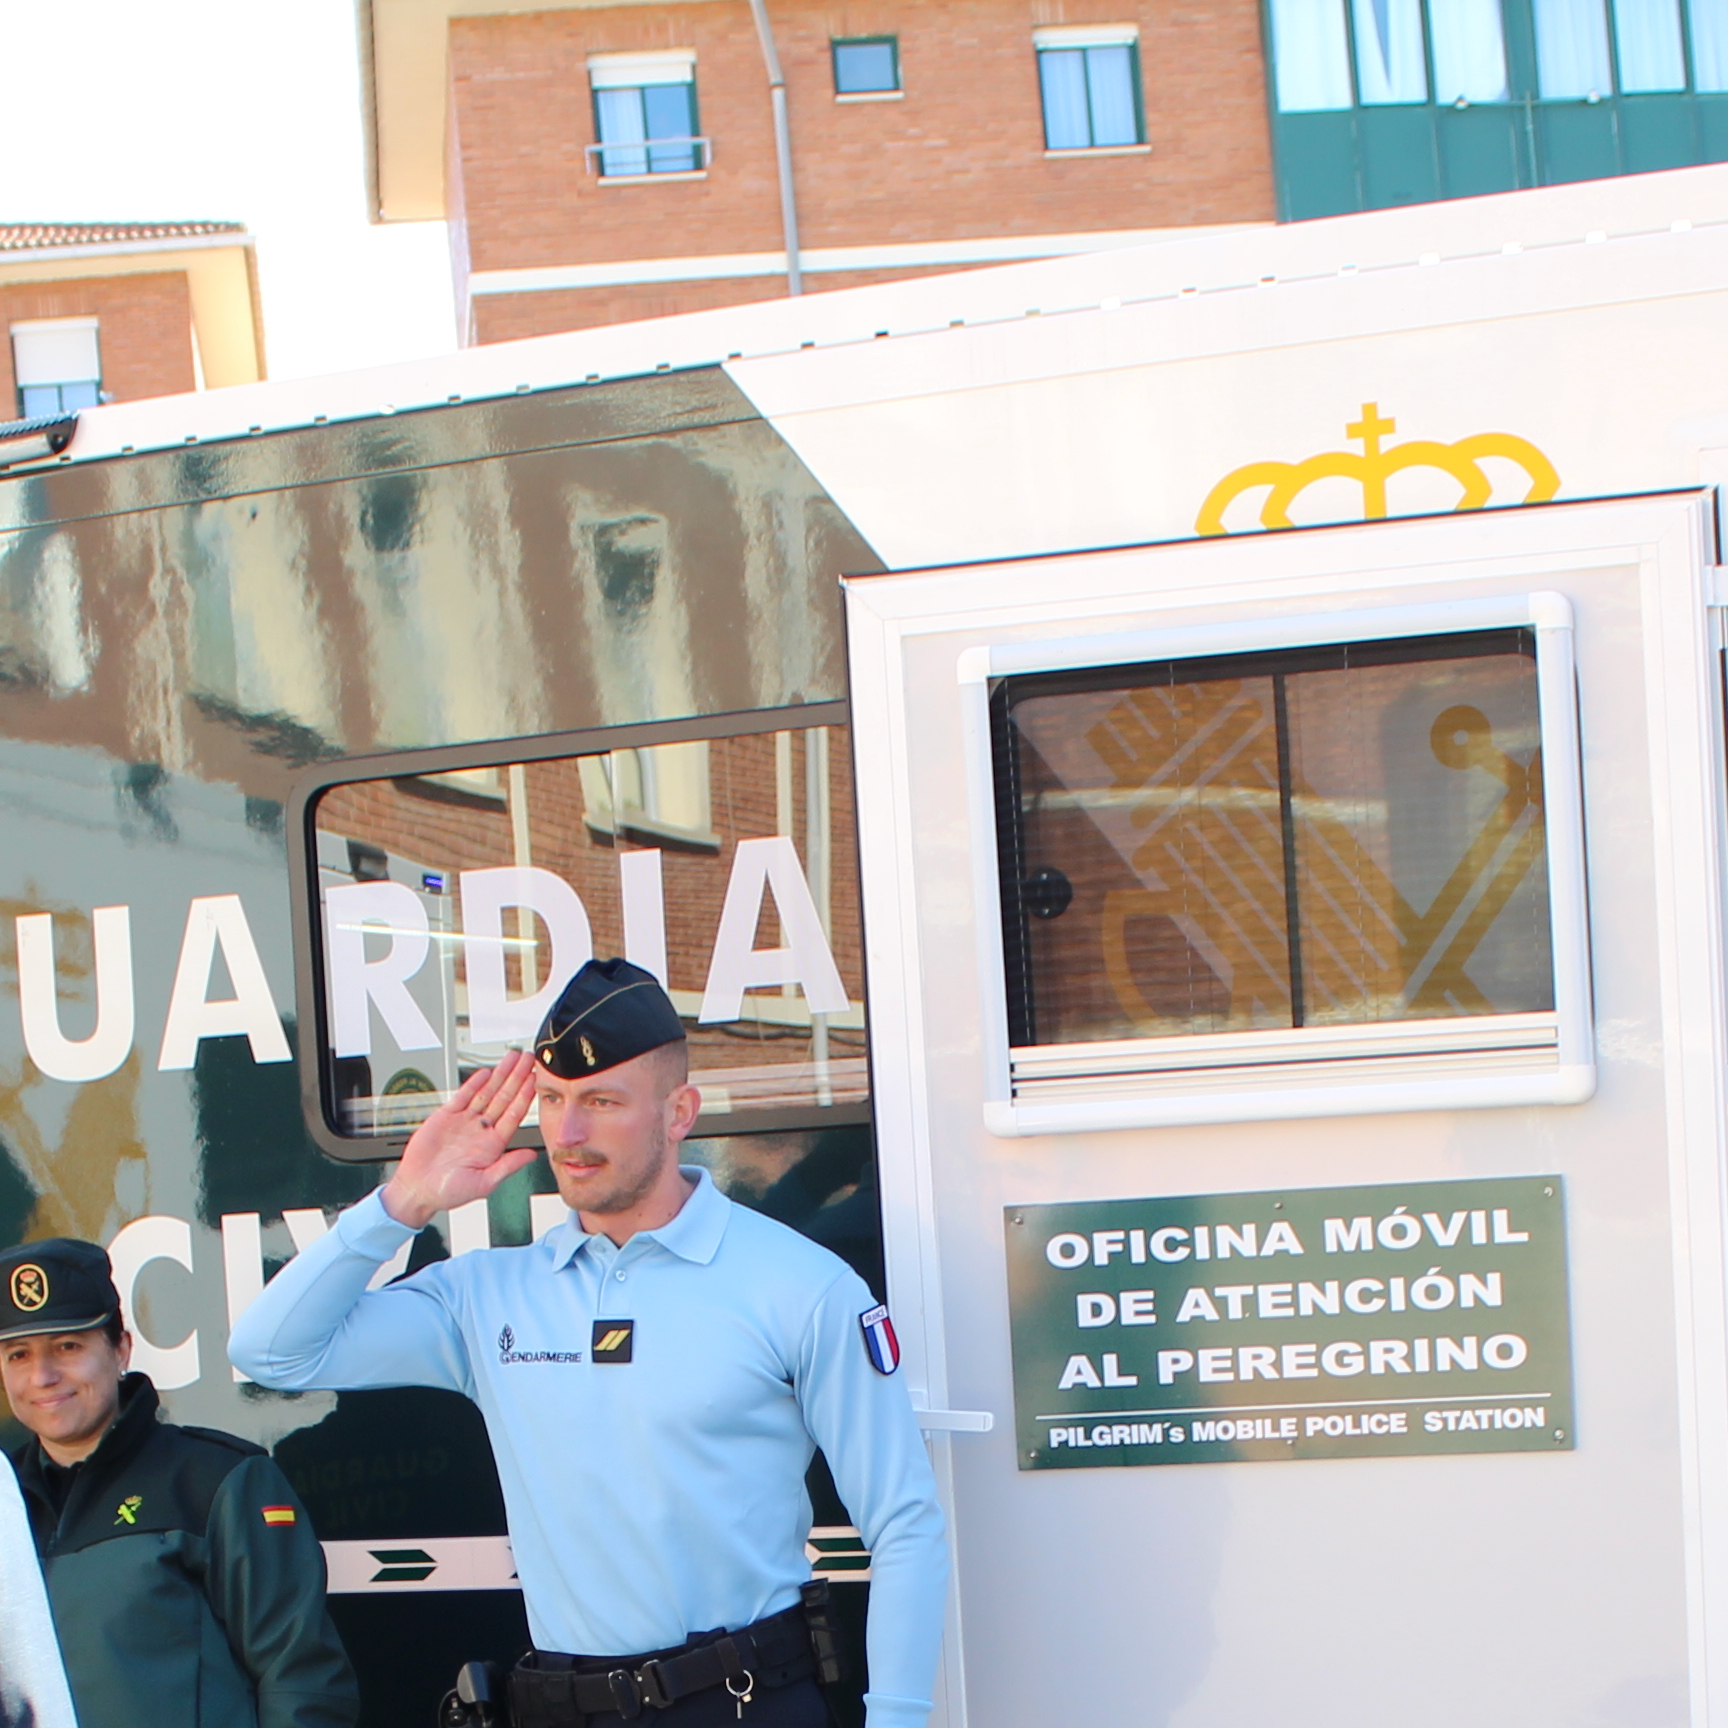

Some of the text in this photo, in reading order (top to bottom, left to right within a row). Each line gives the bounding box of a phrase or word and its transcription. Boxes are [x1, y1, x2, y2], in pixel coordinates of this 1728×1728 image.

[1046, 1206, 1529, 1268] OFICINA MÓVIL
[1076, 1267, 1502, 1328] DE ATENCIÓN
[499, 1351, 582, 1365] GENDARMERIE
[1058, 1333, 1527, 1390] AL PEREGRINO
[1192, 1415, 1298, 1444] MOBILE
[1306, 1412, 1408, 1438] POLICE
[1424, 1407, 1545, 1432] STATION
